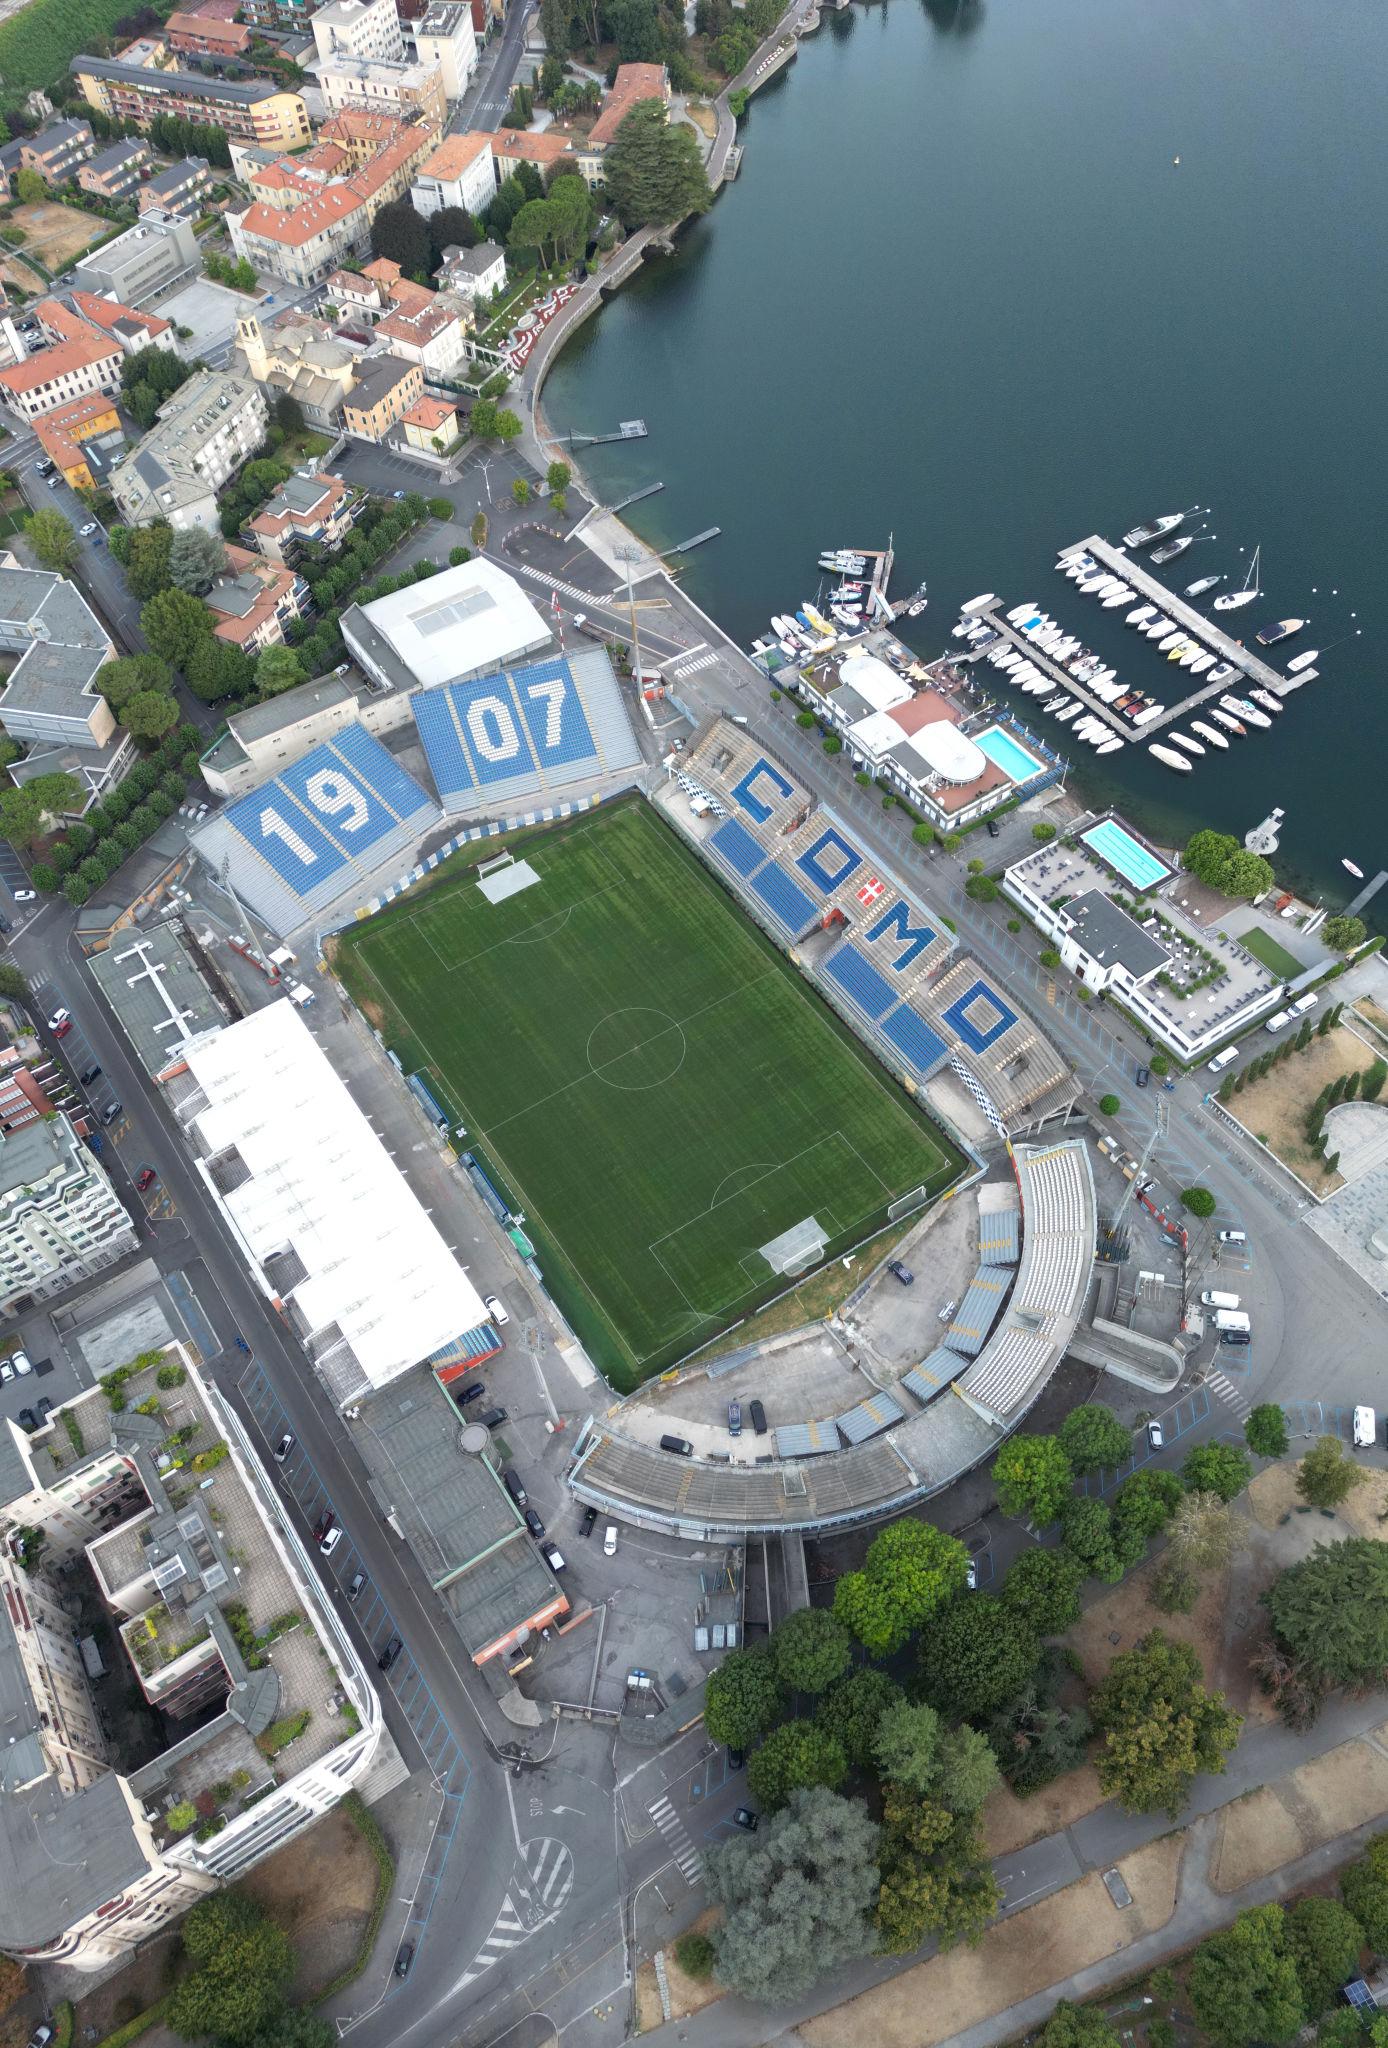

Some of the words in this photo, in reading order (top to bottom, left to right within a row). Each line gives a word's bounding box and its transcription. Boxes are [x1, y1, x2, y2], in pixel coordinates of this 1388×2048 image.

[730, 757, 1020, 1055] COMO
[529, 1797, 544, 1817] STOP
[526, 1903, 545, 1925] STOP
